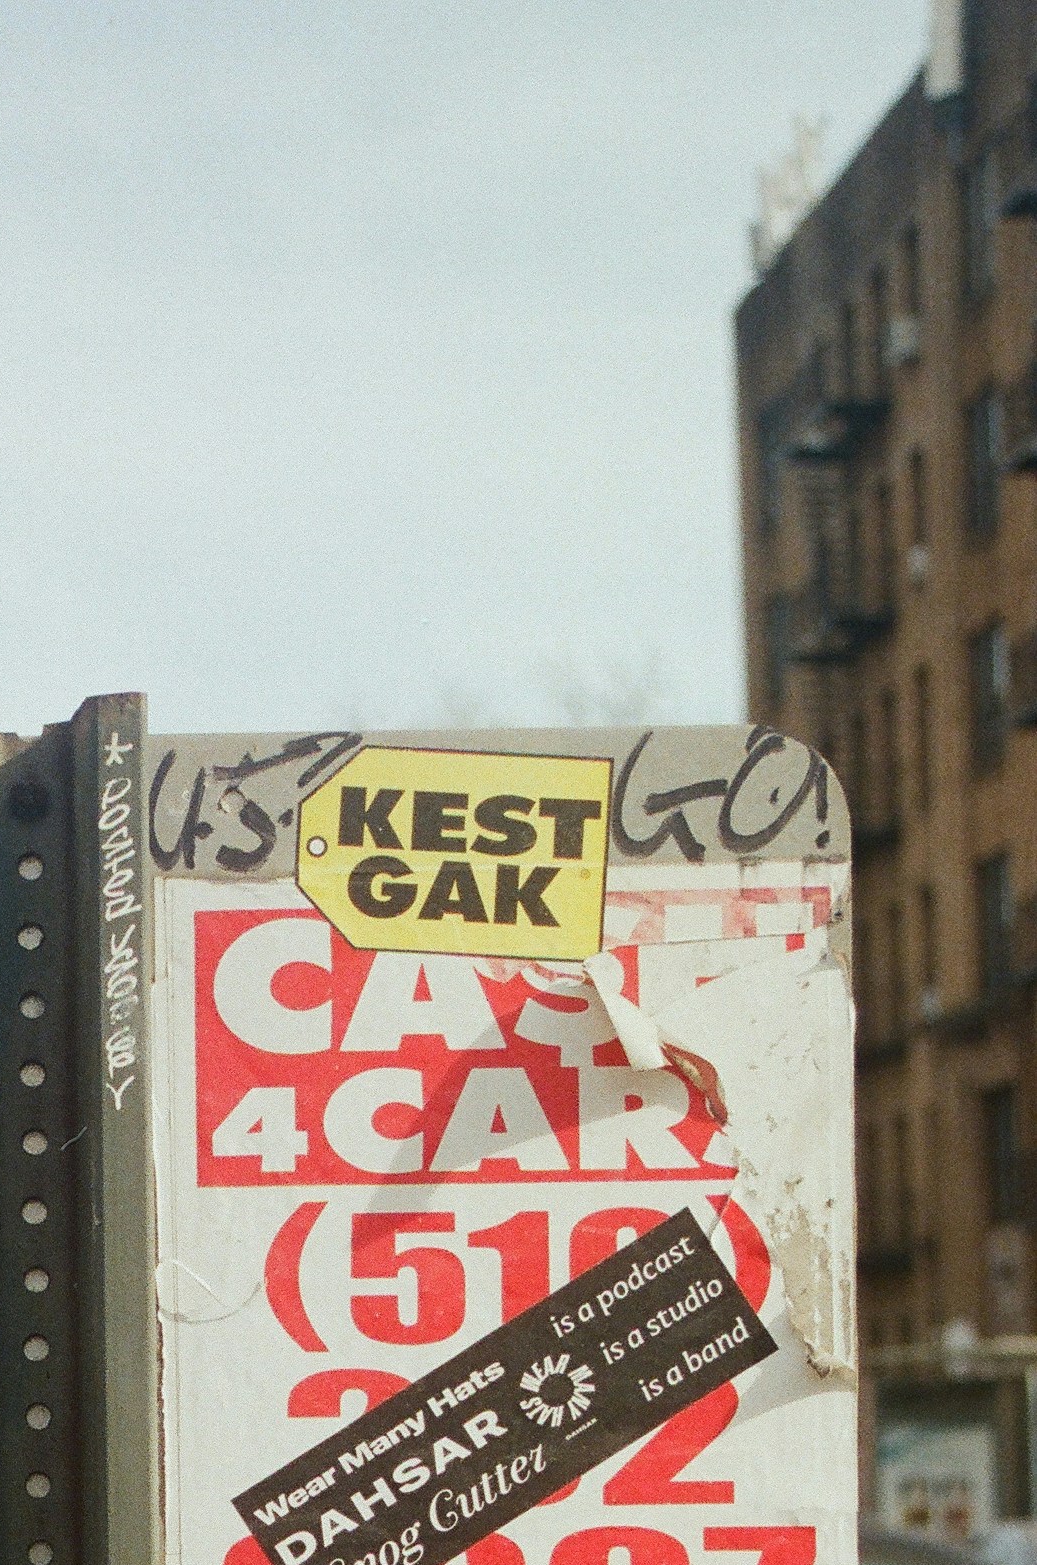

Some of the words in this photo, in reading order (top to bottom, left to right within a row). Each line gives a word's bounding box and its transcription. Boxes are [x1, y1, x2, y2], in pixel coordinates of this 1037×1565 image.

[337, 785, 602, 861] KEST
[347, 855, 562, 928] GAK
[214, 918, 630, 1056] CAS
[550, 1315, 575, 1338] is
[578, 1302, 595, 1322] a
[596, 1236, 695, 1317] podcast
[600, 1340, 625, 1365] is
[627, 1328, 645, 1349] a
[647, 1279, 723, 1336] studio
[519, 1354, 570, 1393] WEAR
[567, 1364, 596, 1421] MANY
[638, 1378, 664, 1402] is
[666, 1365, 684, 1386] a
[682, 1316, 750, 1374] band
[253, 1466, 337, 1527] Wear
[338, 1409, 427, 1474] Many
[427, 1361, 505, 1418] Hats
[519, 1397, 565, 1428] HATS
[429, 1443, 547, 1533] Cutter
